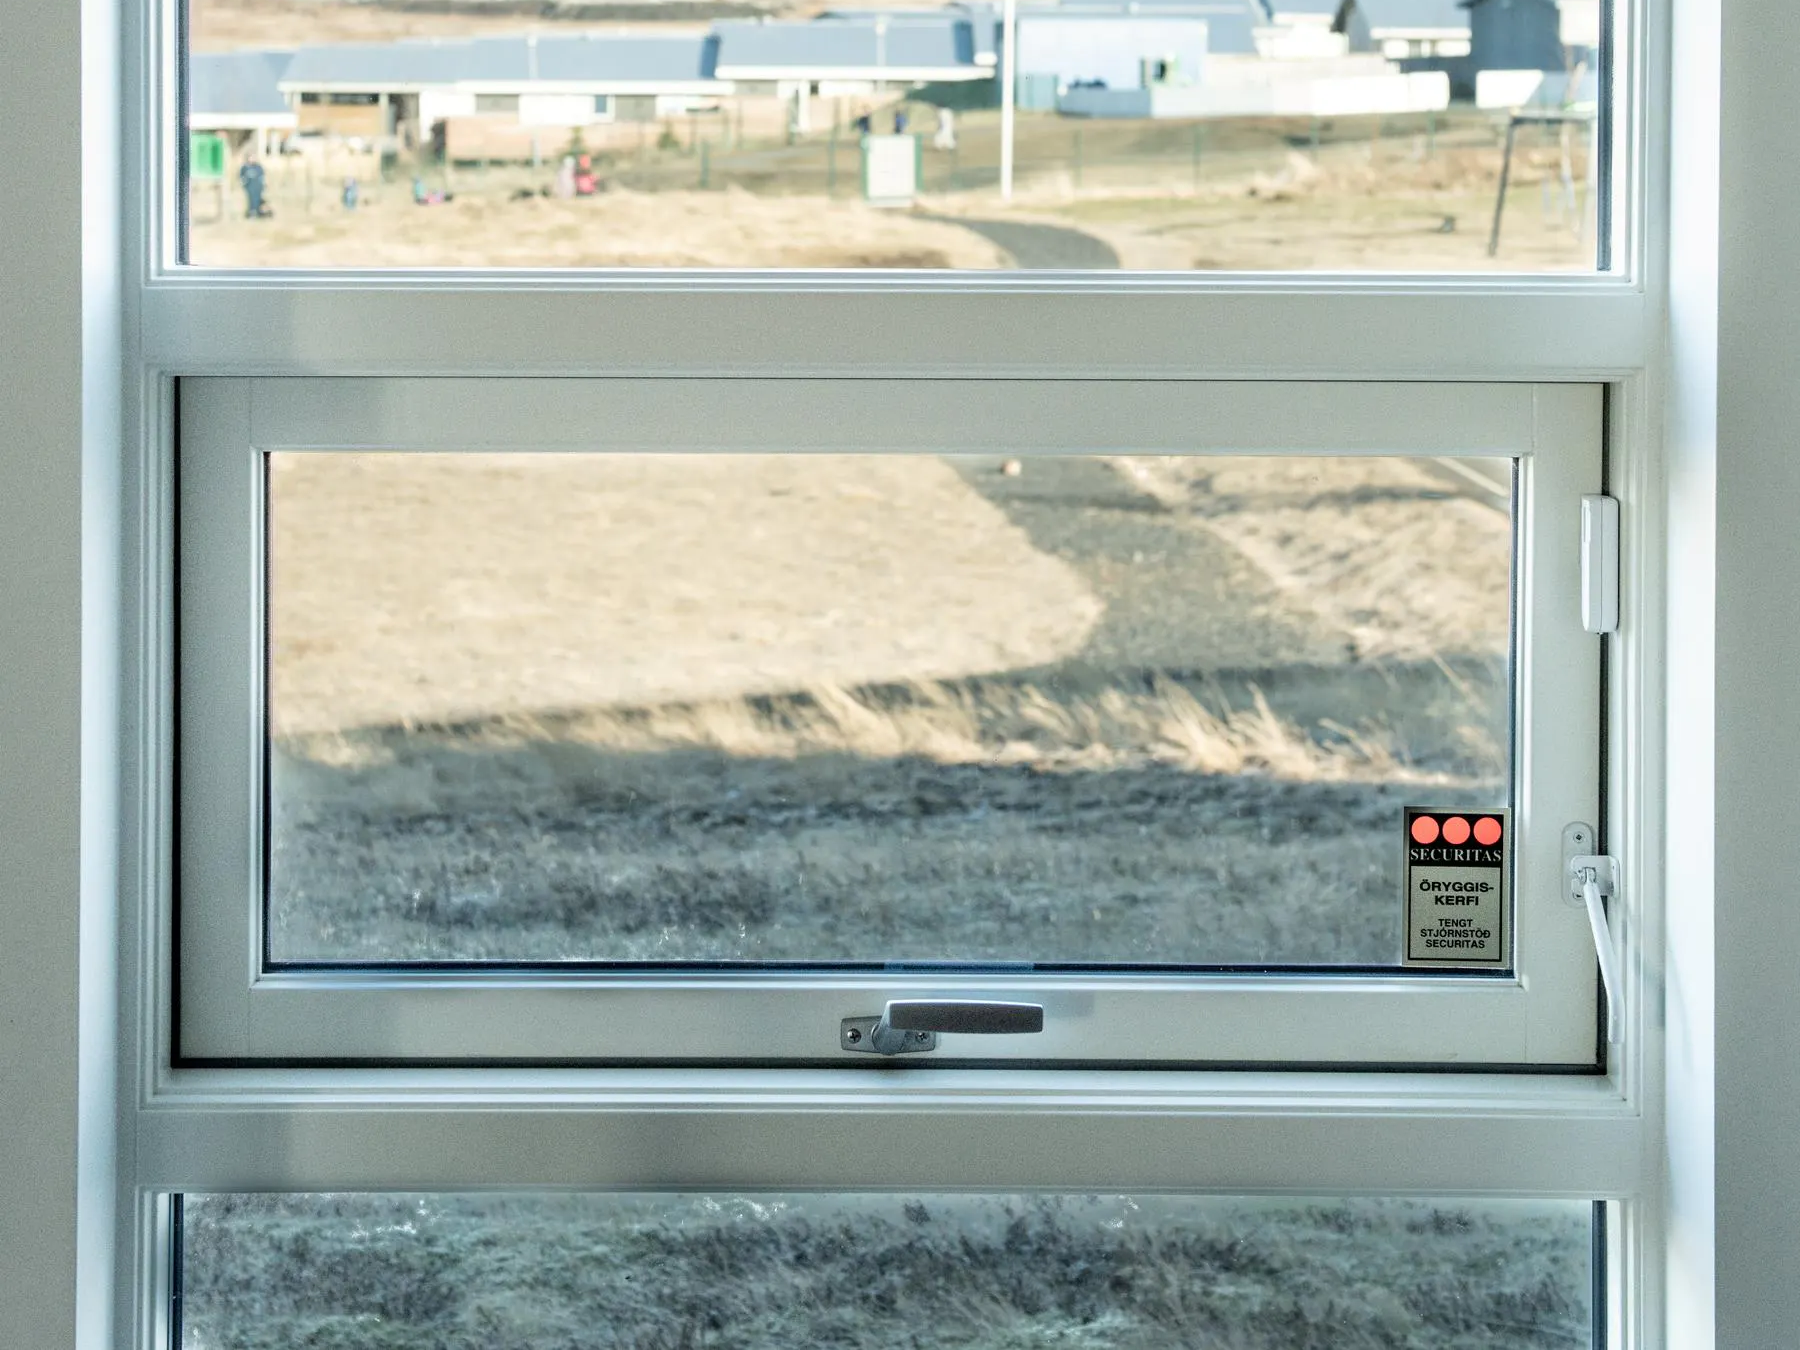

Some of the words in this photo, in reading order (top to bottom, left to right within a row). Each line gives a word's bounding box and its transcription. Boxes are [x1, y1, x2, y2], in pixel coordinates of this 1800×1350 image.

[1410, 848, 1502, 862] SECURITAS
[1420, 879, 1494, 892] ÖRYGGIS-
[1434, 895, 1479, 906] KERFI
[1438, 918, 1473, 927] TENGT
[1425, 939, 1485, 949] SECURITAS
